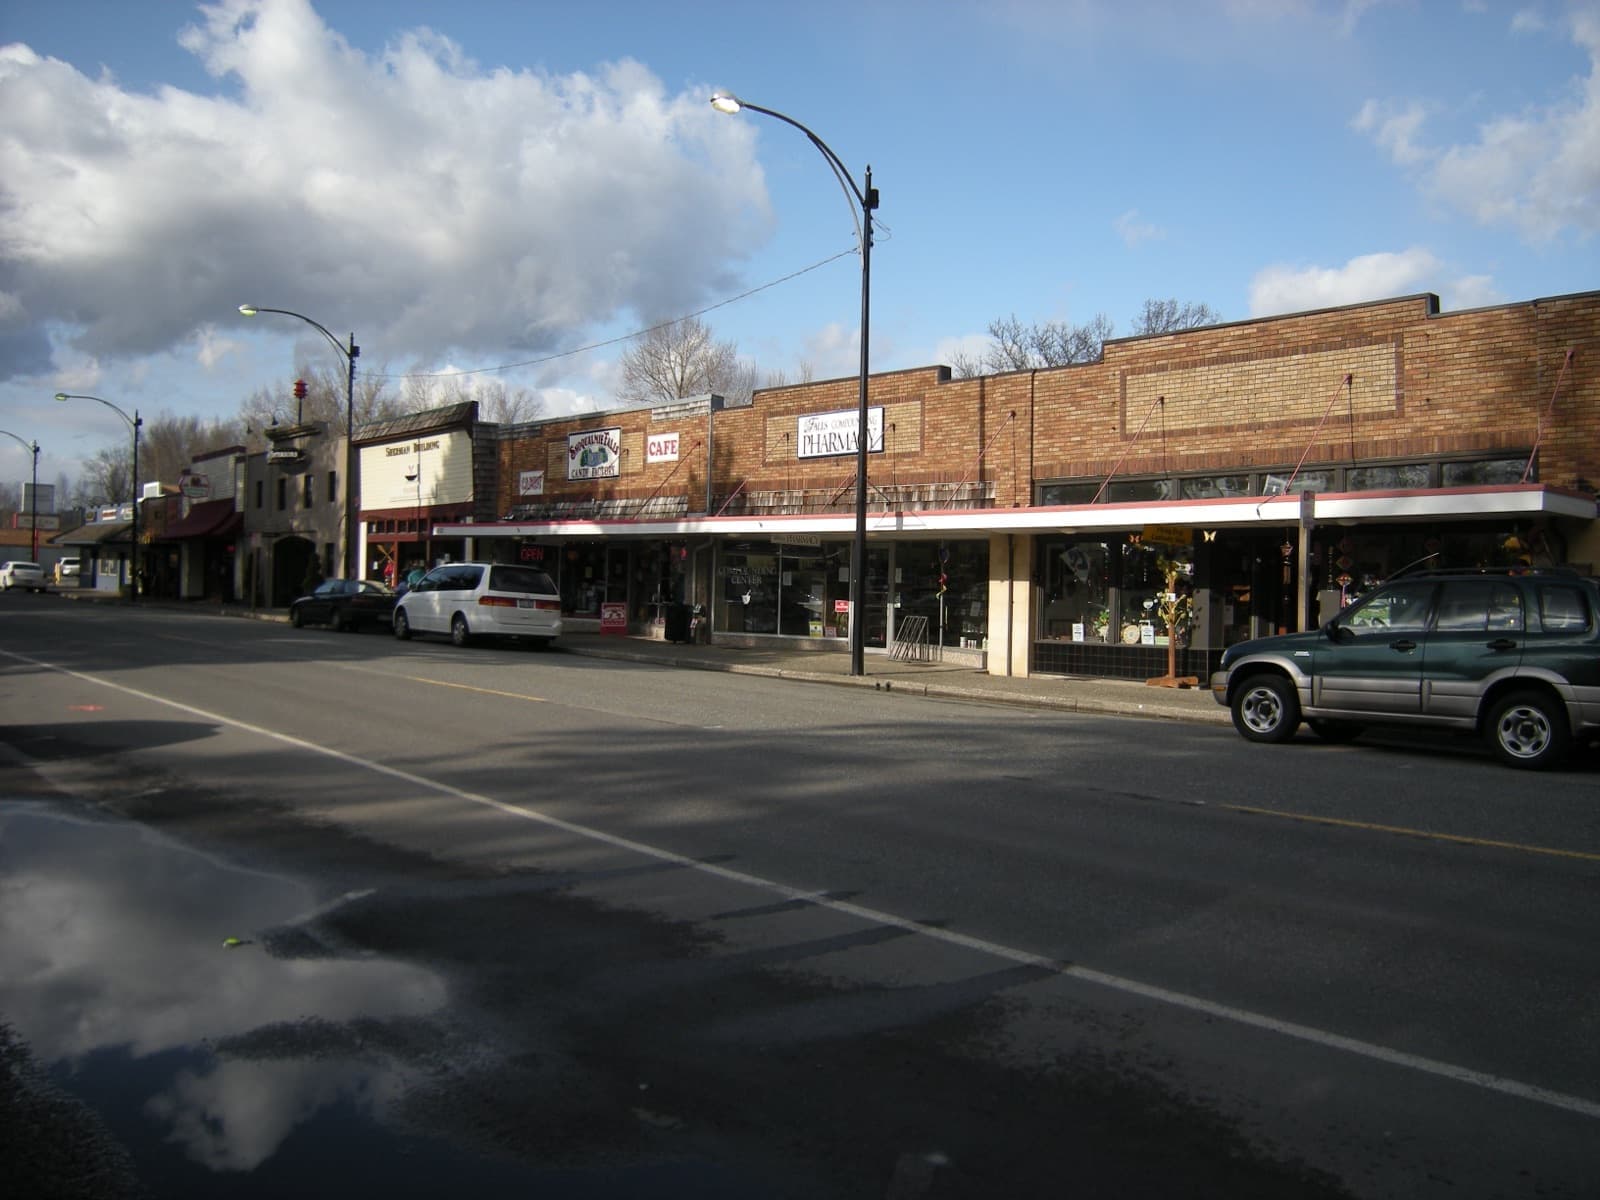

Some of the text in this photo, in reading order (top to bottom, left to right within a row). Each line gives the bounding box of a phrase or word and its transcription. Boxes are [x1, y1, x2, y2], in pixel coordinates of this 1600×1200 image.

[569, 431, 620, 460] SNOQUALMIE FALLS
[649, 440, 677, 456] CAFE
[803, 429, 881, 455] PHARMAY
[731, 575, 762, 585] CENTER
